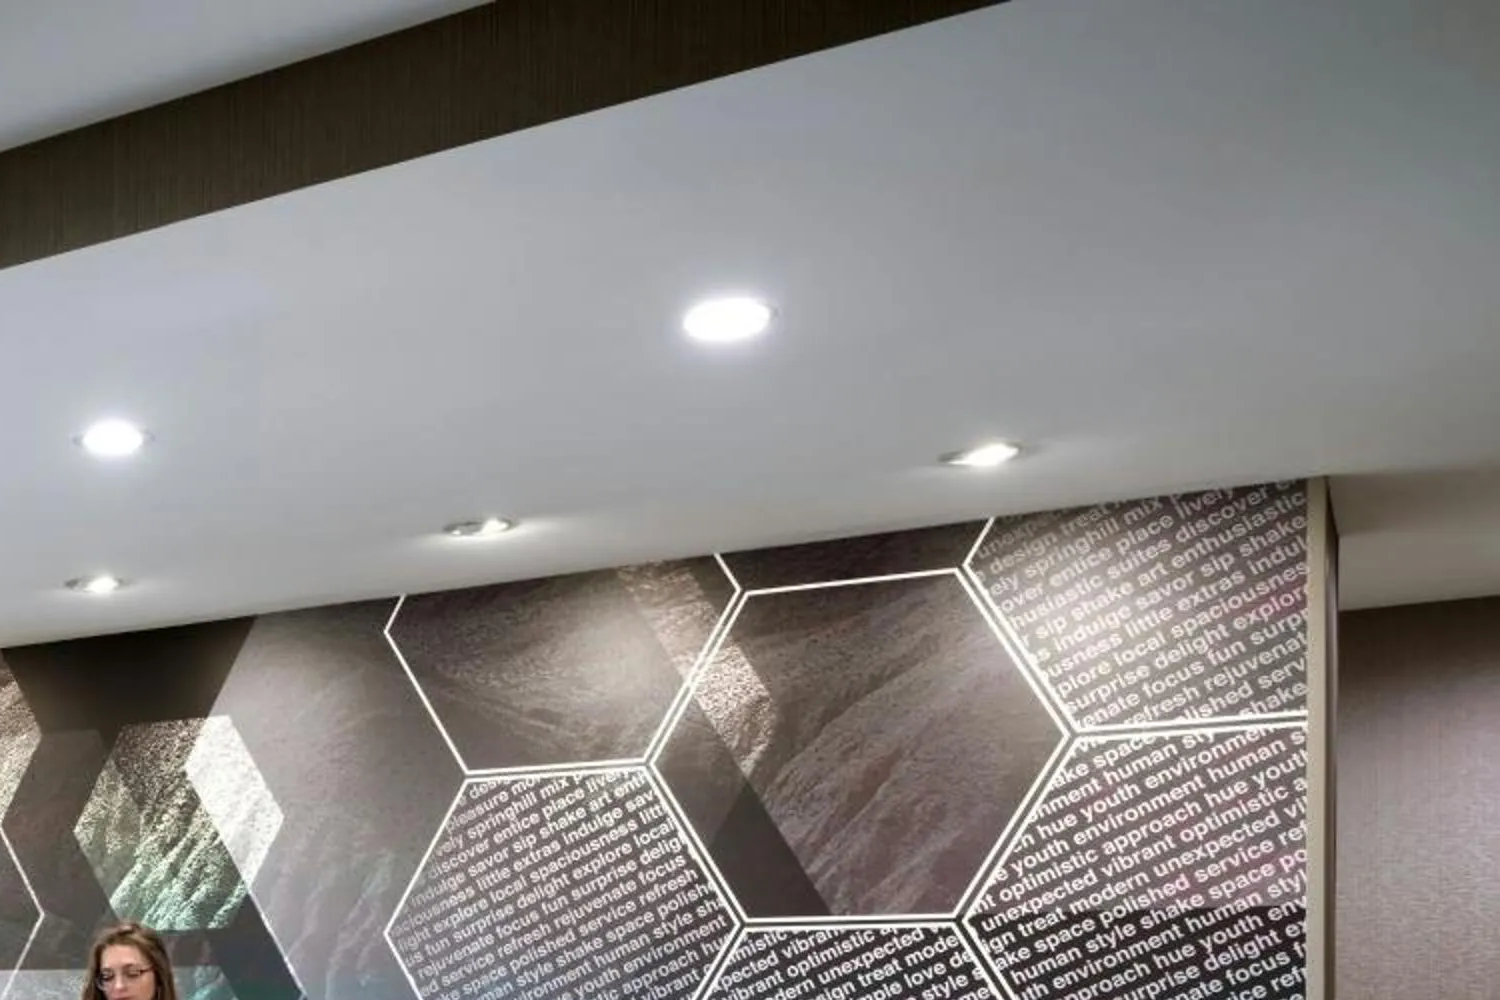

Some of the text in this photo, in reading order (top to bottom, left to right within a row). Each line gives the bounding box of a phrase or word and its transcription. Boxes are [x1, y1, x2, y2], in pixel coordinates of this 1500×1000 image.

[985, 529, 1057, 573] design
[1022, 514, 1120, 576] springhill
[1122, 495, 1163, 523] mix
[1034, 615, 1070, 640] sip
[1069, 579, 1135, 621] shake
[1136, 557, 1168, 586] art
[1169, 491, 1306, 568] enthusiastic
[1048, 513, 1175, 587] entice place
[1106, 537, 1172, 578] suites
[1172, 486, 1269, 543] discover
[1051, 514, 1307, 652] indulge savor sip shake
[1122, 605, 1173, 638] little
[1175, 569, 1246, 612] extras
[1065, 618, 1229, 714] surprise delight
[1110, 626, 1166, 666] local
[1139, 639, 1245, 699] focus fun
[1102, 743, 1178, 784] human
[465, 790, 539, 837] springhill
[539, 776, 569, 798] mix
[467, 847, 512, 877] savor
[511, 833, 539, 853] sip
[538, 806, 587, 839] shake
[587, 789, 612, 812] art
[491, 811, 541, 844] entice
[541, 787, 586, 820] place
[997, 847, 1099, 901] optimistic
[1101, 796, 1201, 854] approach
[1203, 779, 1250, 808] hue
[1010, 834, 1069, 878] youth
[1071, 771, 1207, 845] environment
[1206, 739, 1286, 783] human
[1036, 778, 1140, 839] hue youth
[432, 819, 638, 933] explore local spaciousness
[473, 806, 623, 891] little extras indulge
[980, 866, 1097, 932] unexpected
[1100, 831, 1176, 878] vibrant
[1178, 784, 1290, 843] optimistic
[1015, 902, 1067, 938] treat
[1069, 870, 1149, 914] modern
[1152, 808, 1281, 878] unexpected
[417, 858, 638, 978] rejuvenate focus fun surprise
[422, 935, 451, 957] fun
[452, 903, 515, 942] surprise
[514, 870, 571, 909] delight
[571, 840, 632, 879] explore
[439, 853, 685, 985] service refresh rejuvenate focus
[461, 865, 698, 994] space polished service refresh
[1009, 945, 1082, 986] human
[1084, 921, 1136, 953] style
[1139, 892, 1204, 930] shake
[1208, 861, 1276, 900] space
[1033, 916, 1096, 953] space
[1098, 871, 1190, 929] polished
[1193, 838, 1274, 883] service
[515, 960, 554, 987] style
[554, 935, 604, 968] shake
[605, 910, 655, 943] space
[574, 963, 620, 1000] youth
[623, 911, 728, 974] environment
[592, 932, 649, 967] human
[652, 910, 693, 939] style
[621, 946, 699, 996] approach
[785, 930, 876, 978] optimistic
[817, 924, 925, 984] unexpected
[855, 955, 902, 988] treat
[902, 961, 947, 989] love
[1052, 919, 1184, 991] environment
[1184, 890, 1262, 933] human
[1152, 941, 1196, 969] hue
[1199, 910, 1263, 956] youth
[1201, 925, 1282, 973] delight
[1223, 950, 1290, 988] focus
